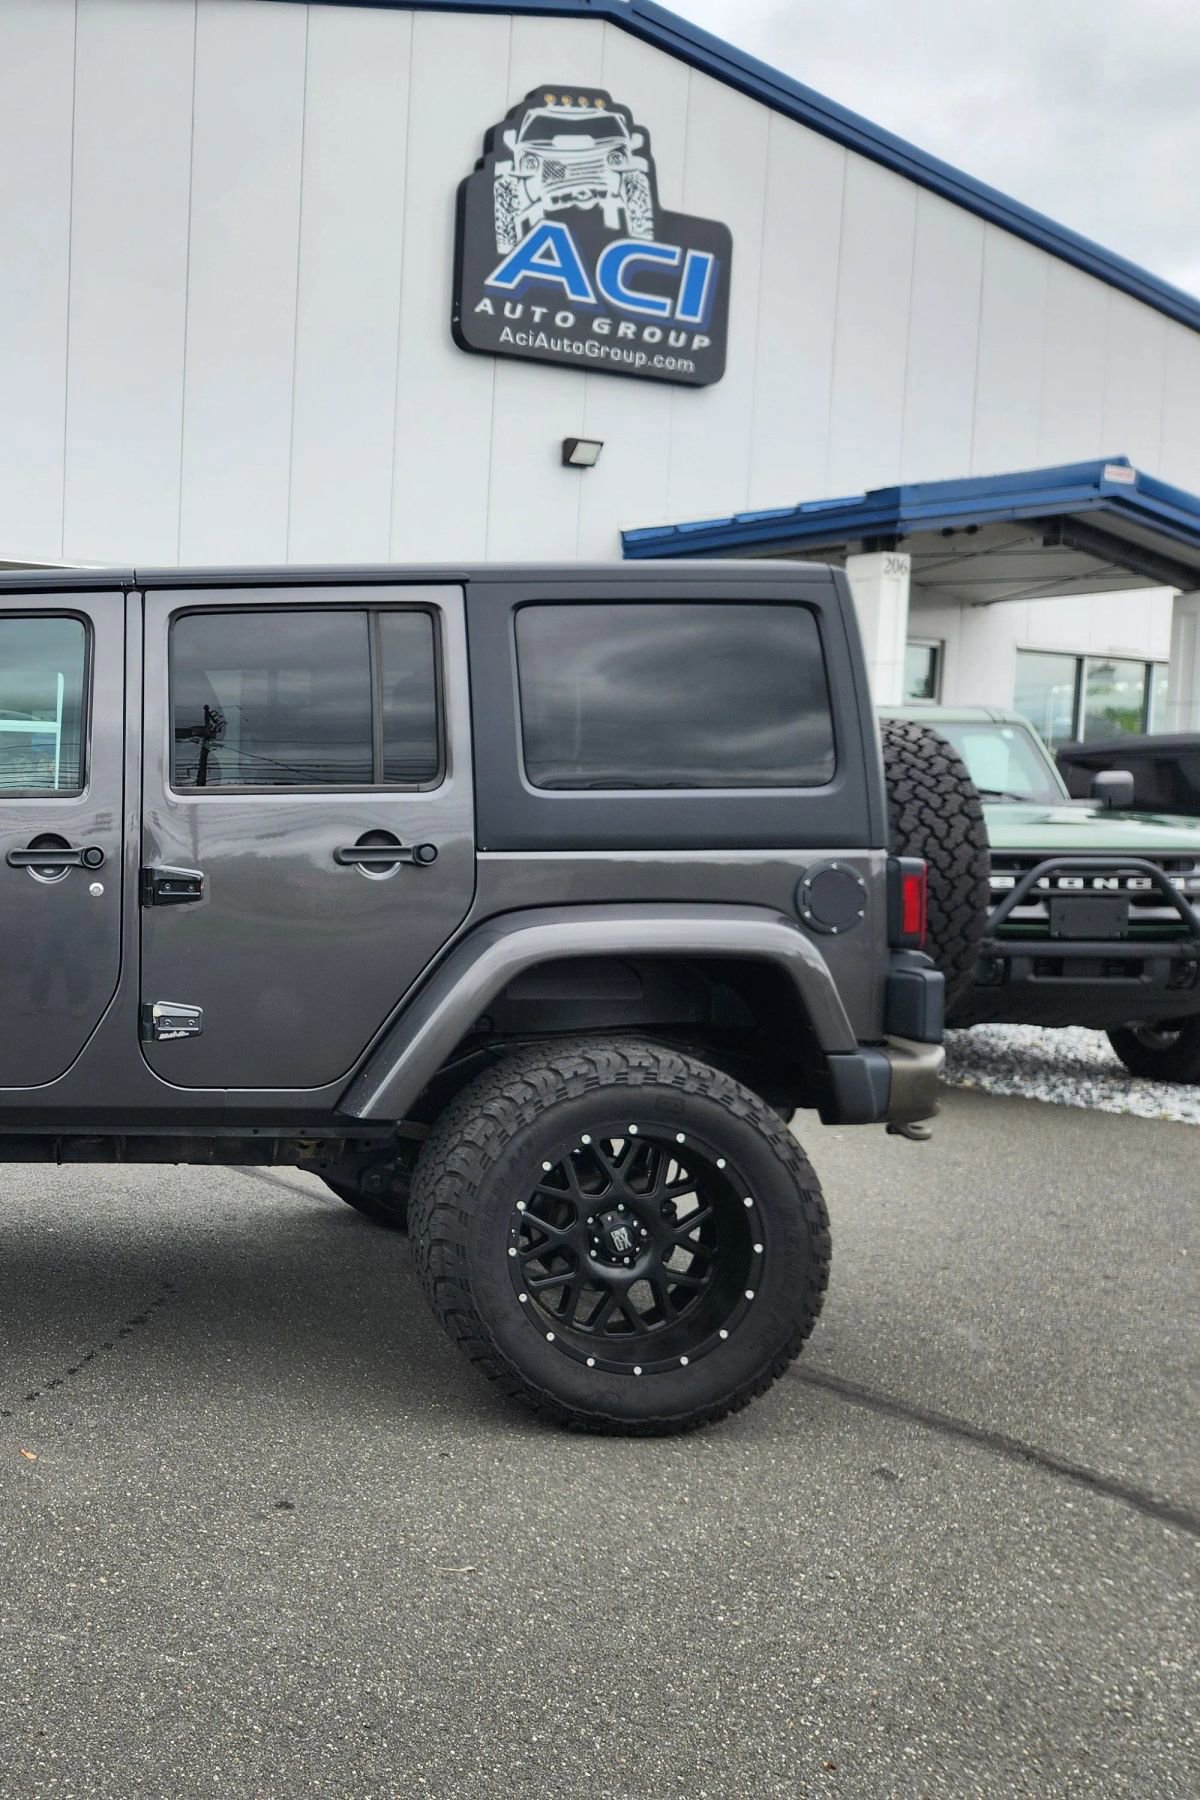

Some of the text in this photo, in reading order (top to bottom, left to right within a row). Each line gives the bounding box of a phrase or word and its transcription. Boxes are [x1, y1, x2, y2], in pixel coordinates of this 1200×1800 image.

[484, 219, 715, 324] ACI
[474, 297, 713, 351] AUTO GROUP
[499, 326, 696, 374] AciAutoGroup.com
